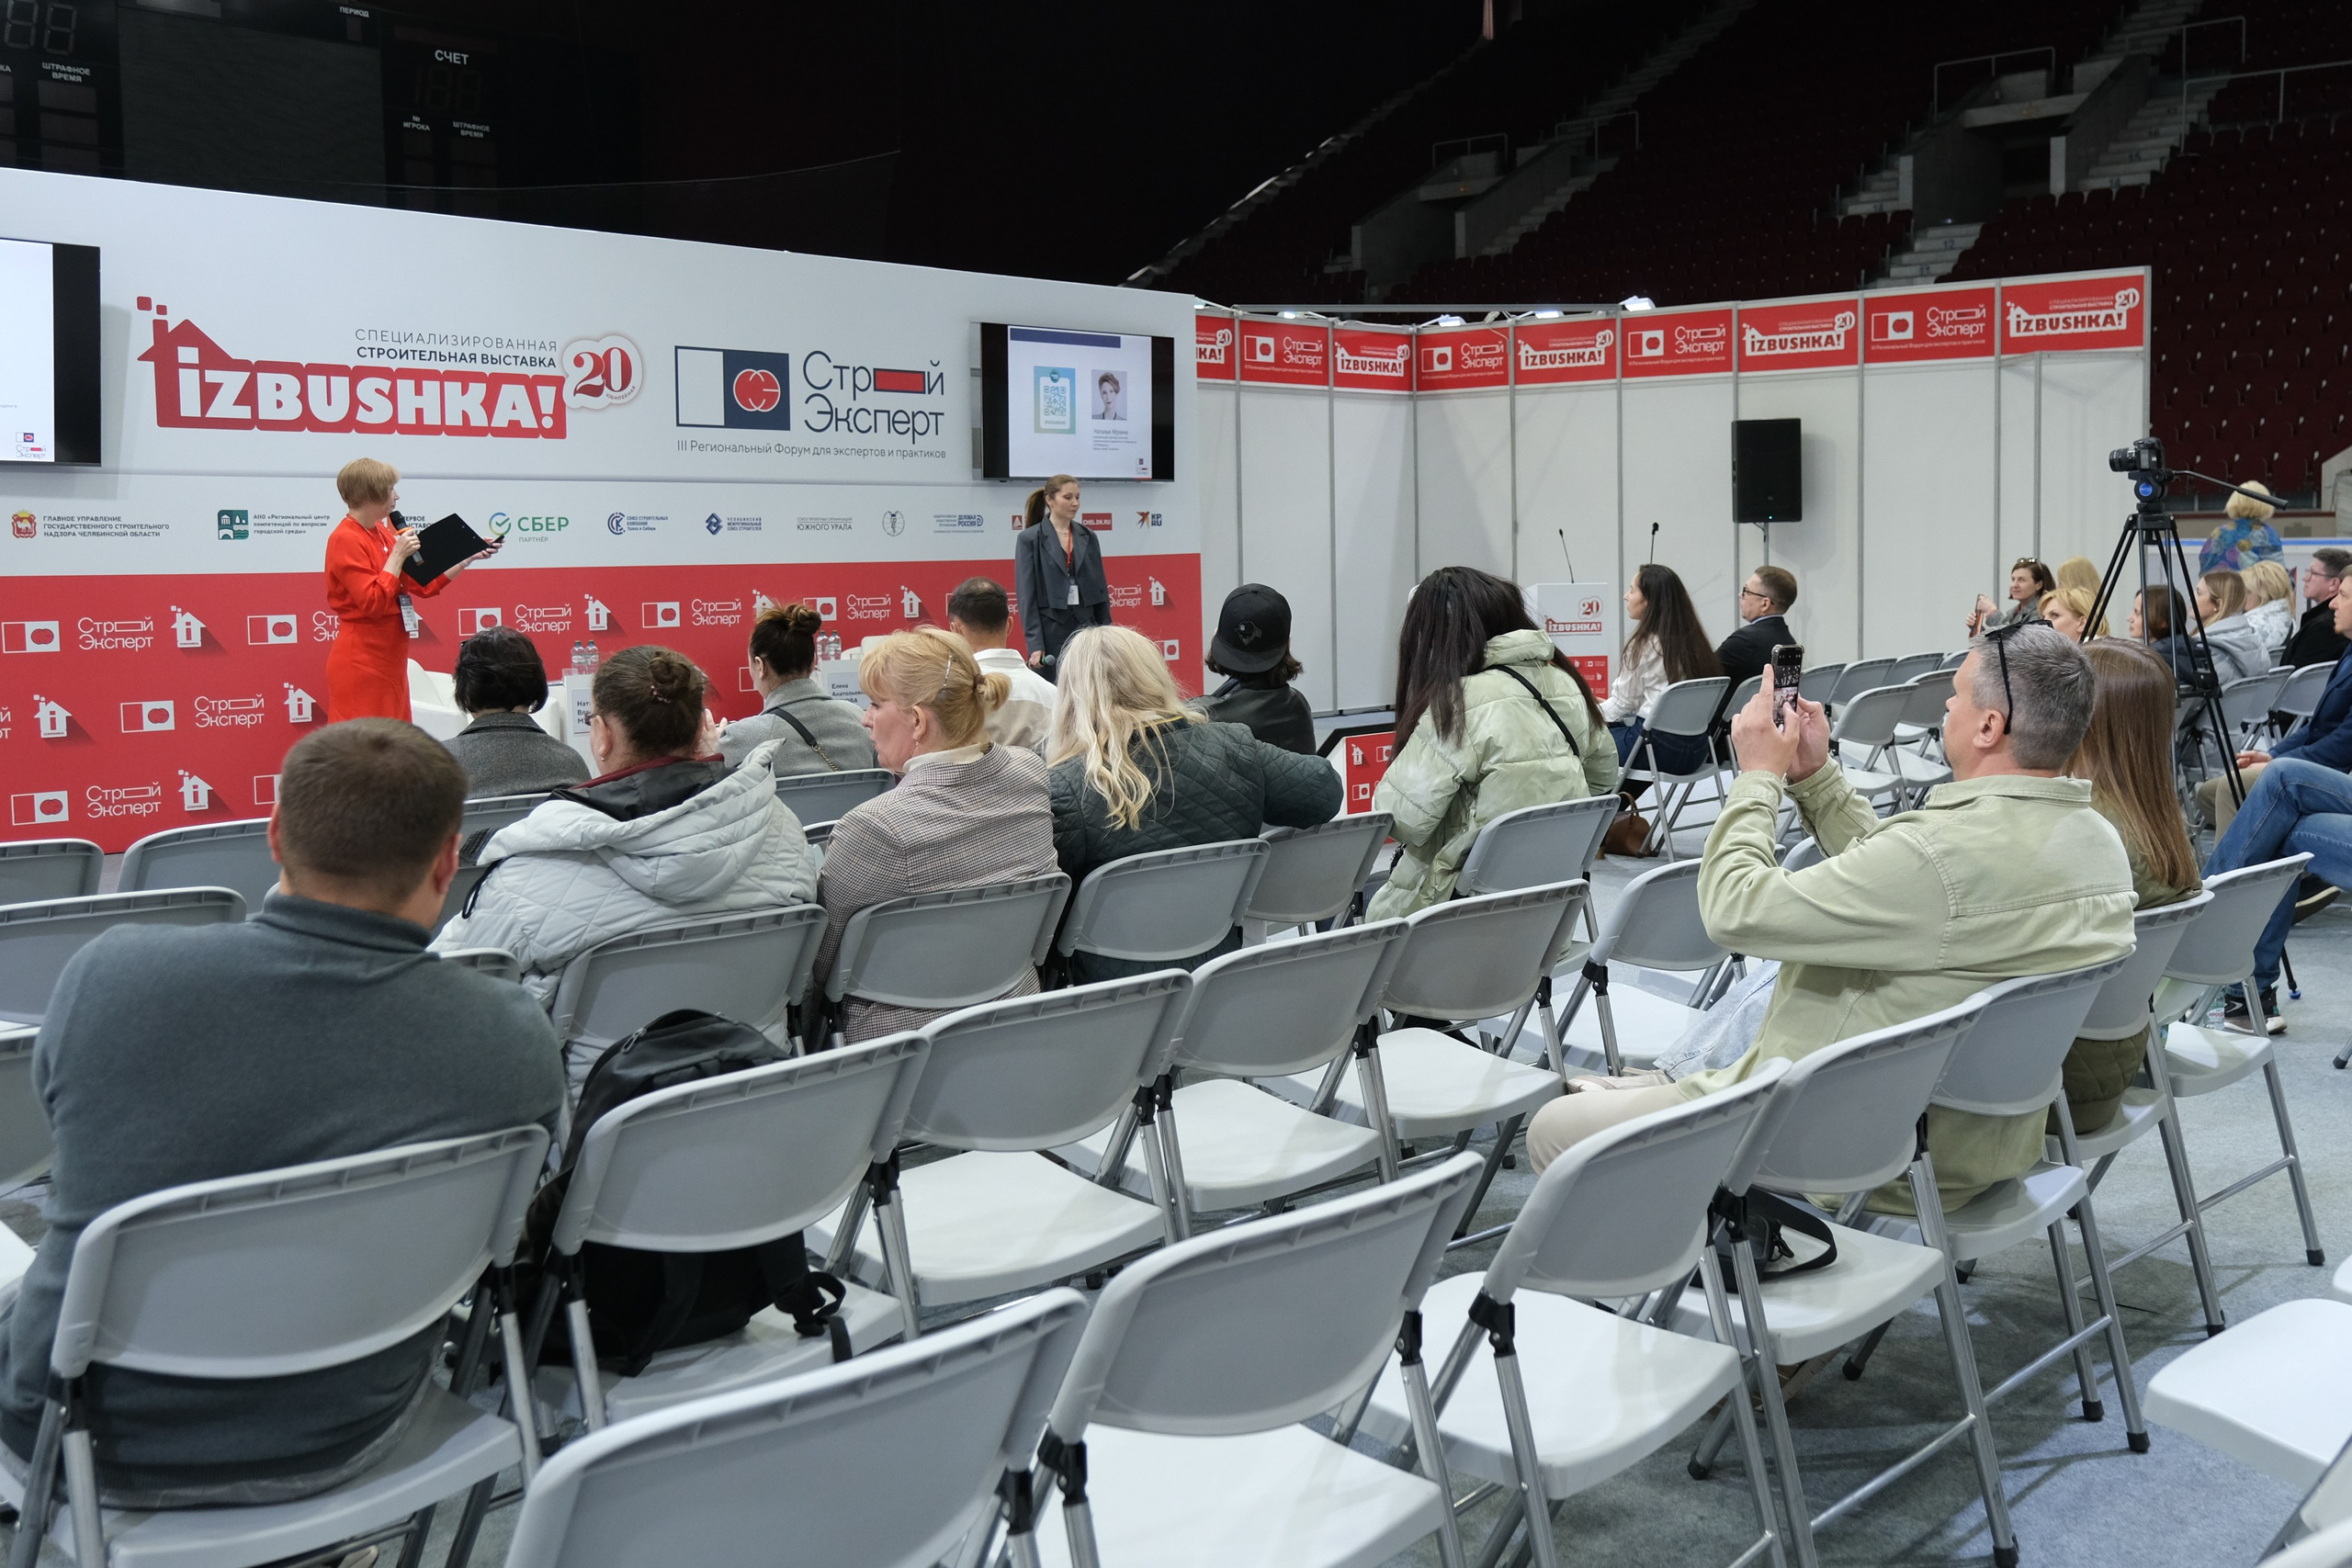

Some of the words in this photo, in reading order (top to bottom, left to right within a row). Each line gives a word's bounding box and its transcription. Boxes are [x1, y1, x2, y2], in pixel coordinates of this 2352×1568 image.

[339, 6, 369, 17] ПЕРИОД
[435, 50, 469, 65] СЧЕТ
[41, 62, 91, 75] ШТРАФНОЕ
[51, 72, 83, 83] ВРЕМЯ
[403, 121, 431, 131] ИГРОКА
[452, 121, 491, 132] ШТРАФНОЕ
[460, 130, 484, 138] ВРЕМЯ
[1926, 321, 1986, 338] Эксперт
[355, 329, 557, 352] СПЕЦИАЛИЗИРОВАННАЯ
[1675, 340, 1725, 355] Эксперт
[356, 346, 478, 364] СТРОИТЕЛЬНАЯ
[481, 354, 557, 368] ВЫСТАВКА
[1283, 350, 1323, 367] Эксперт
[1461, 355, 1504, 369] Эксперт
[572, 346, 633, 398] 20
[605, 385, 637, 401] ЮБИЛЕЙНАЯ
[803, 392, 945, 445] Эксперт
[677, 439, 688, 451] III
[690, 440, 773, 454] Региональный
[774, 443, 811, 457] Форум
[812, 446, 831, 457] для
[832, 446, 887, 459] экспертов
[888, 447, 895, 457] и
[895, 448, 946, 460] практиков
[517, 516, 570, 532] СБЕР
[797, 523, 830, 531] ЮЖНОГО
[831, 523, 853, 531] УРАЛА
[847, 606, 890, 621] Эксперт
[1581, 600, 1600, 615] 20
[515, 619, 571, 634] Эксперт
[691, 613, 741, 626] Эксперт
[78, 634, 154, 652] Эксперт
[195, 711, 265, 729] Эксперт
[86, 800, 162, 818] Эксперт
